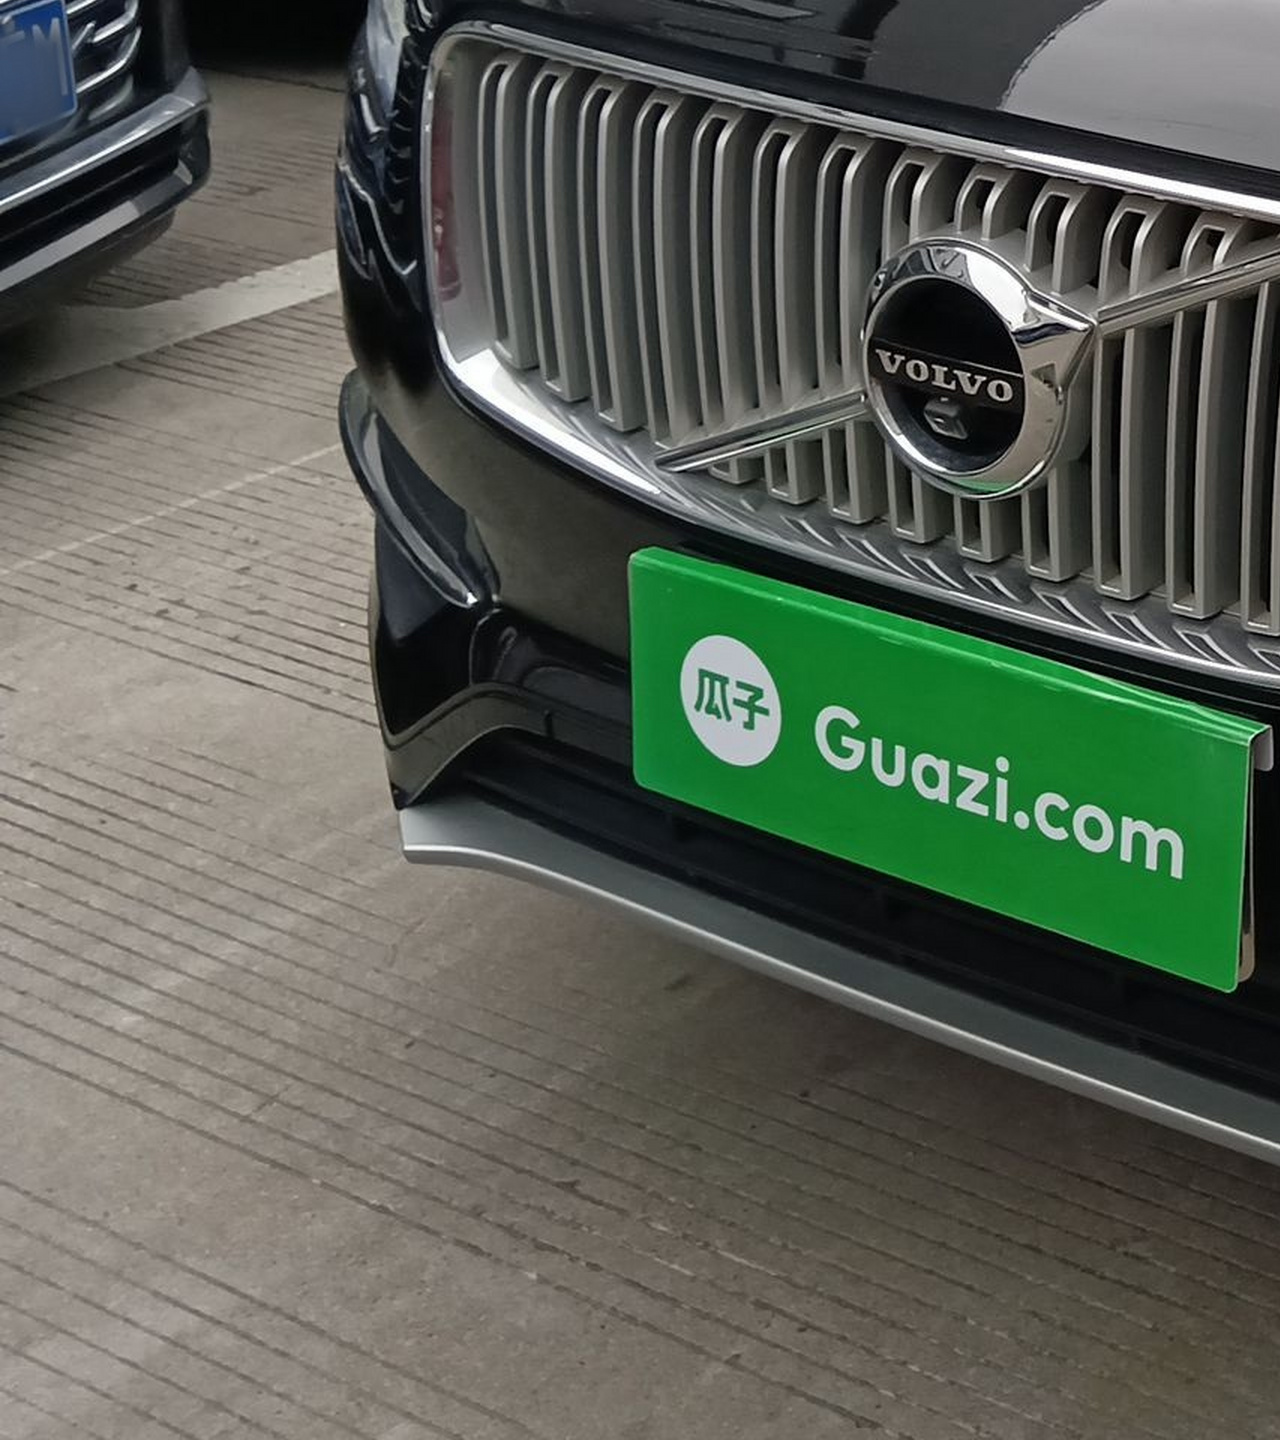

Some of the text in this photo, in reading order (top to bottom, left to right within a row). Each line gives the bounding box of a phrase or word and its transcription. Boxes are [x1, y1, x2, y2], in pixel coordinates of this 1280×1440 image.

[876, 349, 1014, 402] VOLVO
[694, 668, 1185, 880] 瓜子 Guazi.com
